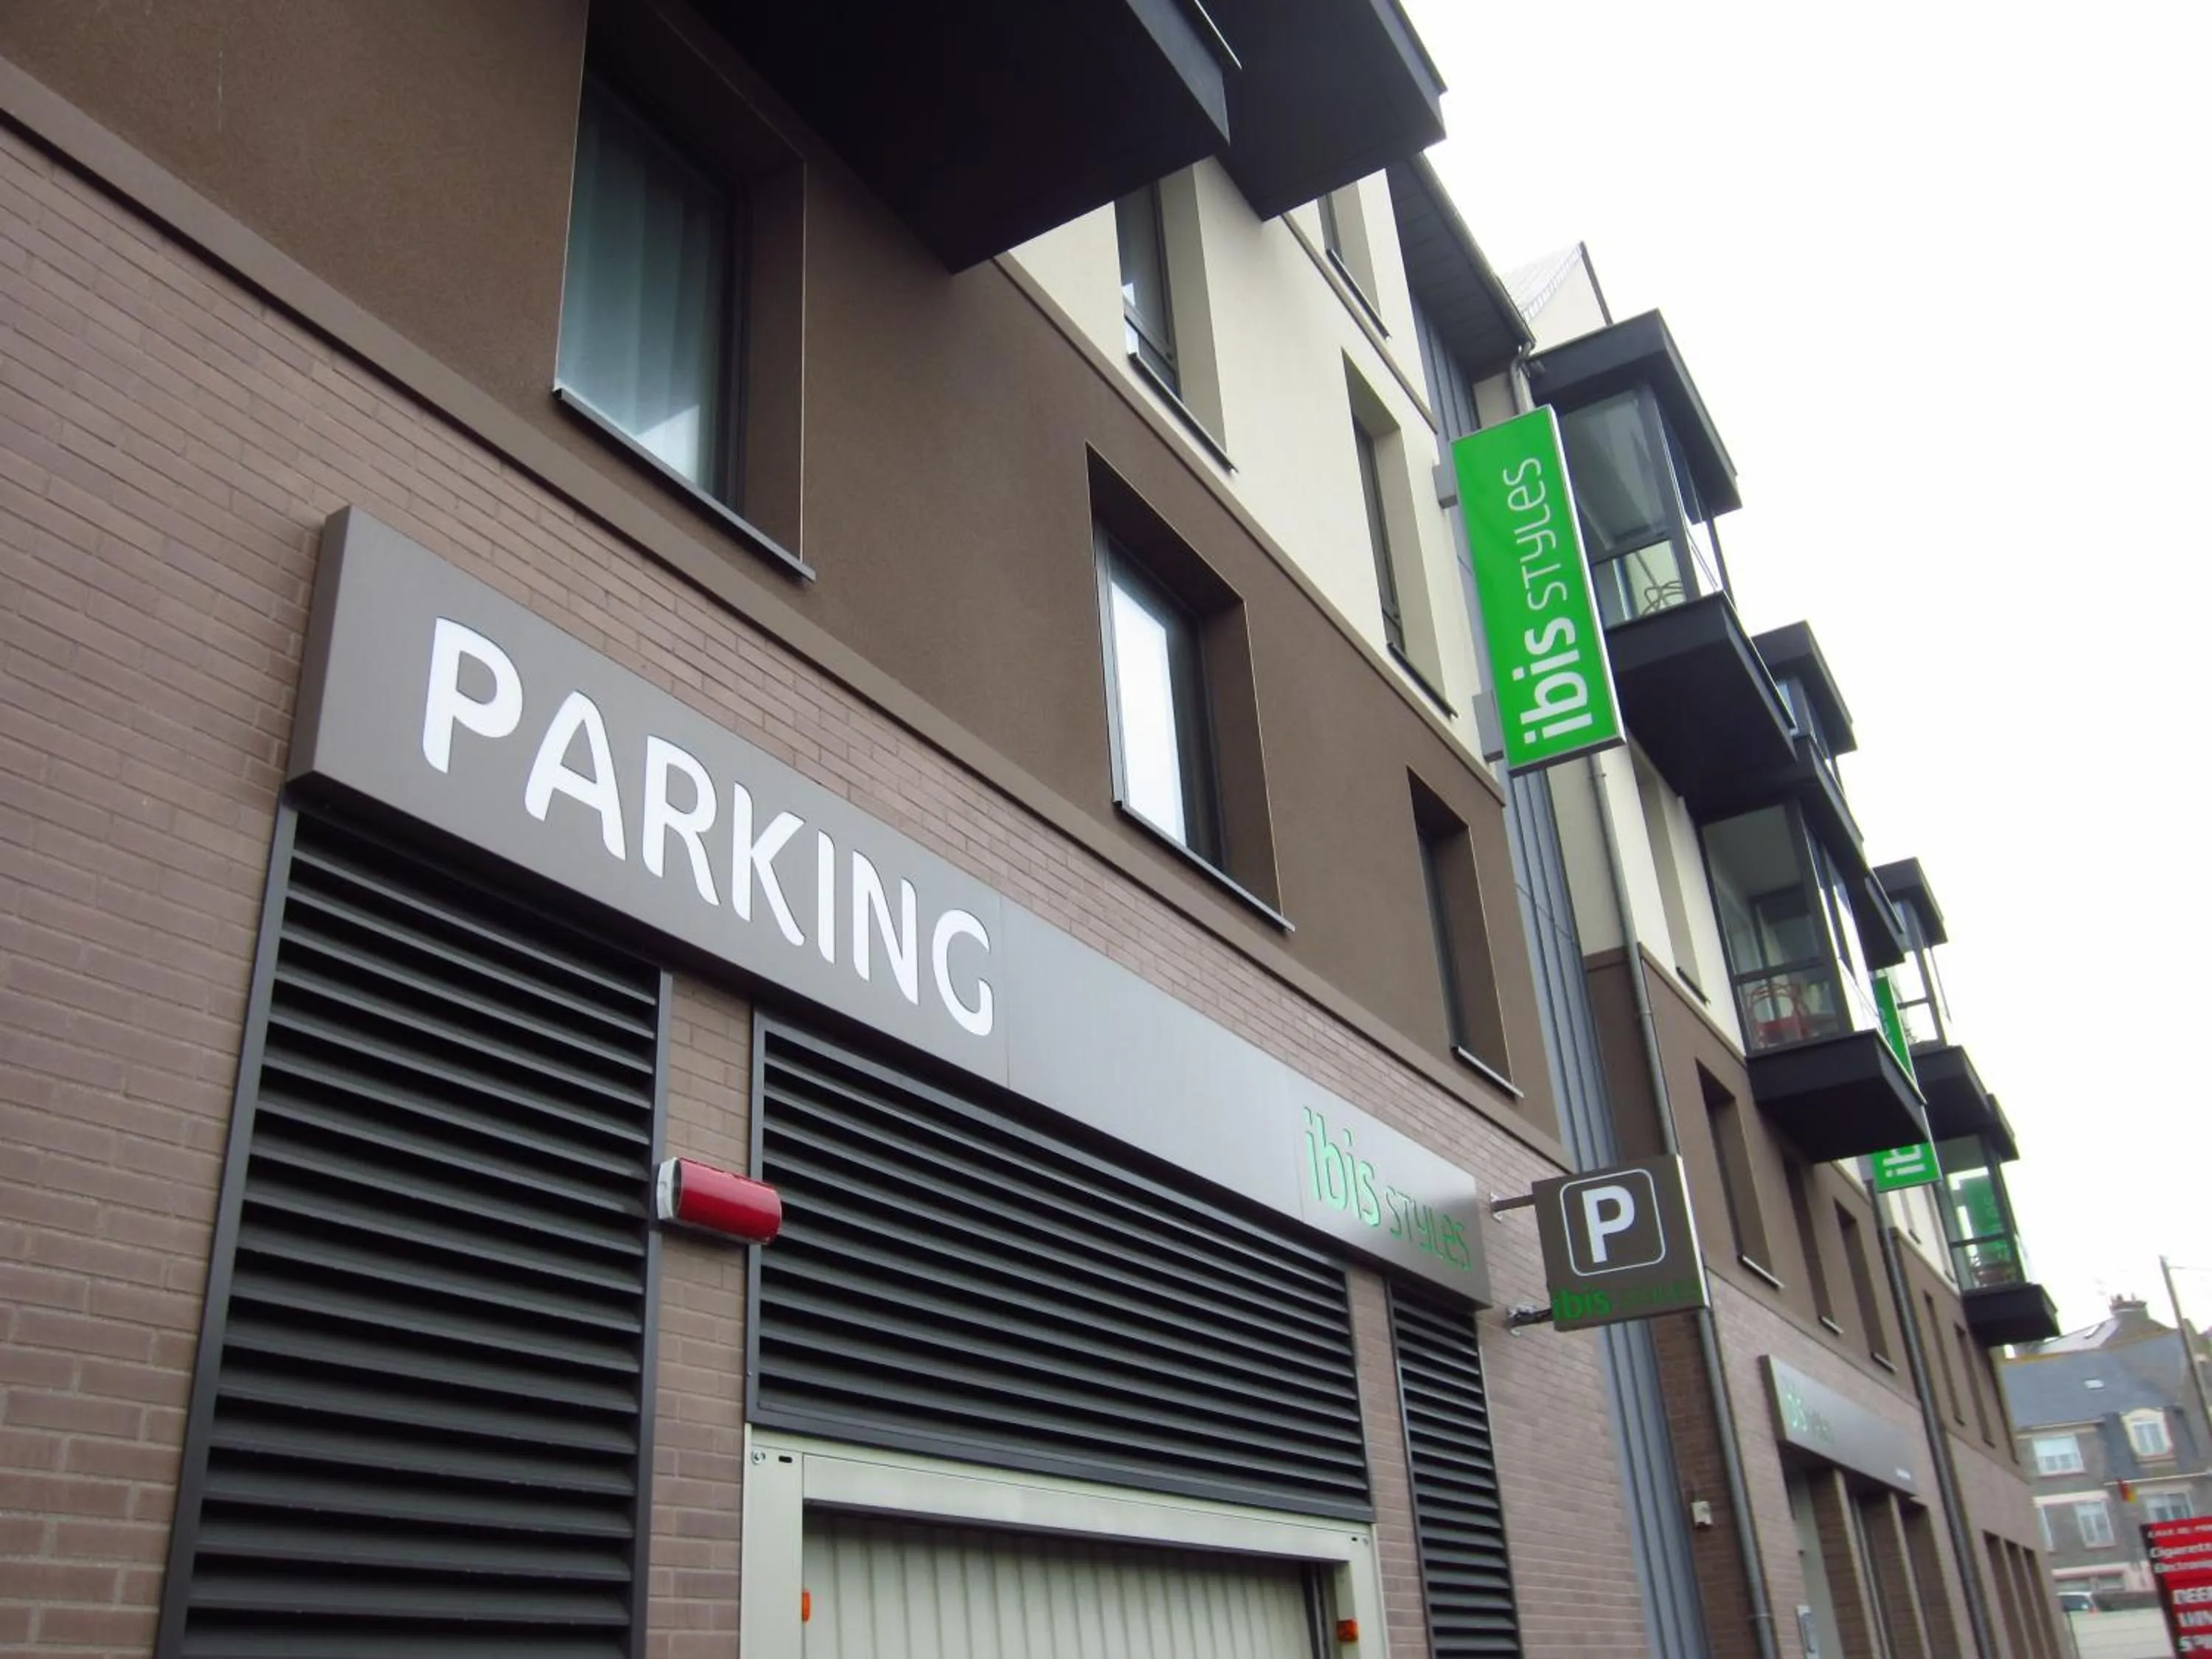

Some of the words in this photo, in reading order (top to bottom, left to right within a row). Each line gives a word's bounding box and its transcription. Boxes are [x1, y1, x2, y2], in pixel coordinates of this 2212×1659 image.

[1512, 617, 1593, 744] ibis
[422, 616, 994, 1036] PARKING
[1303, 1105, 1381, 1228] ibis
[1582, 1185, 1635, 1263] P
[1552, 1282, 1613, 1321] ibis
